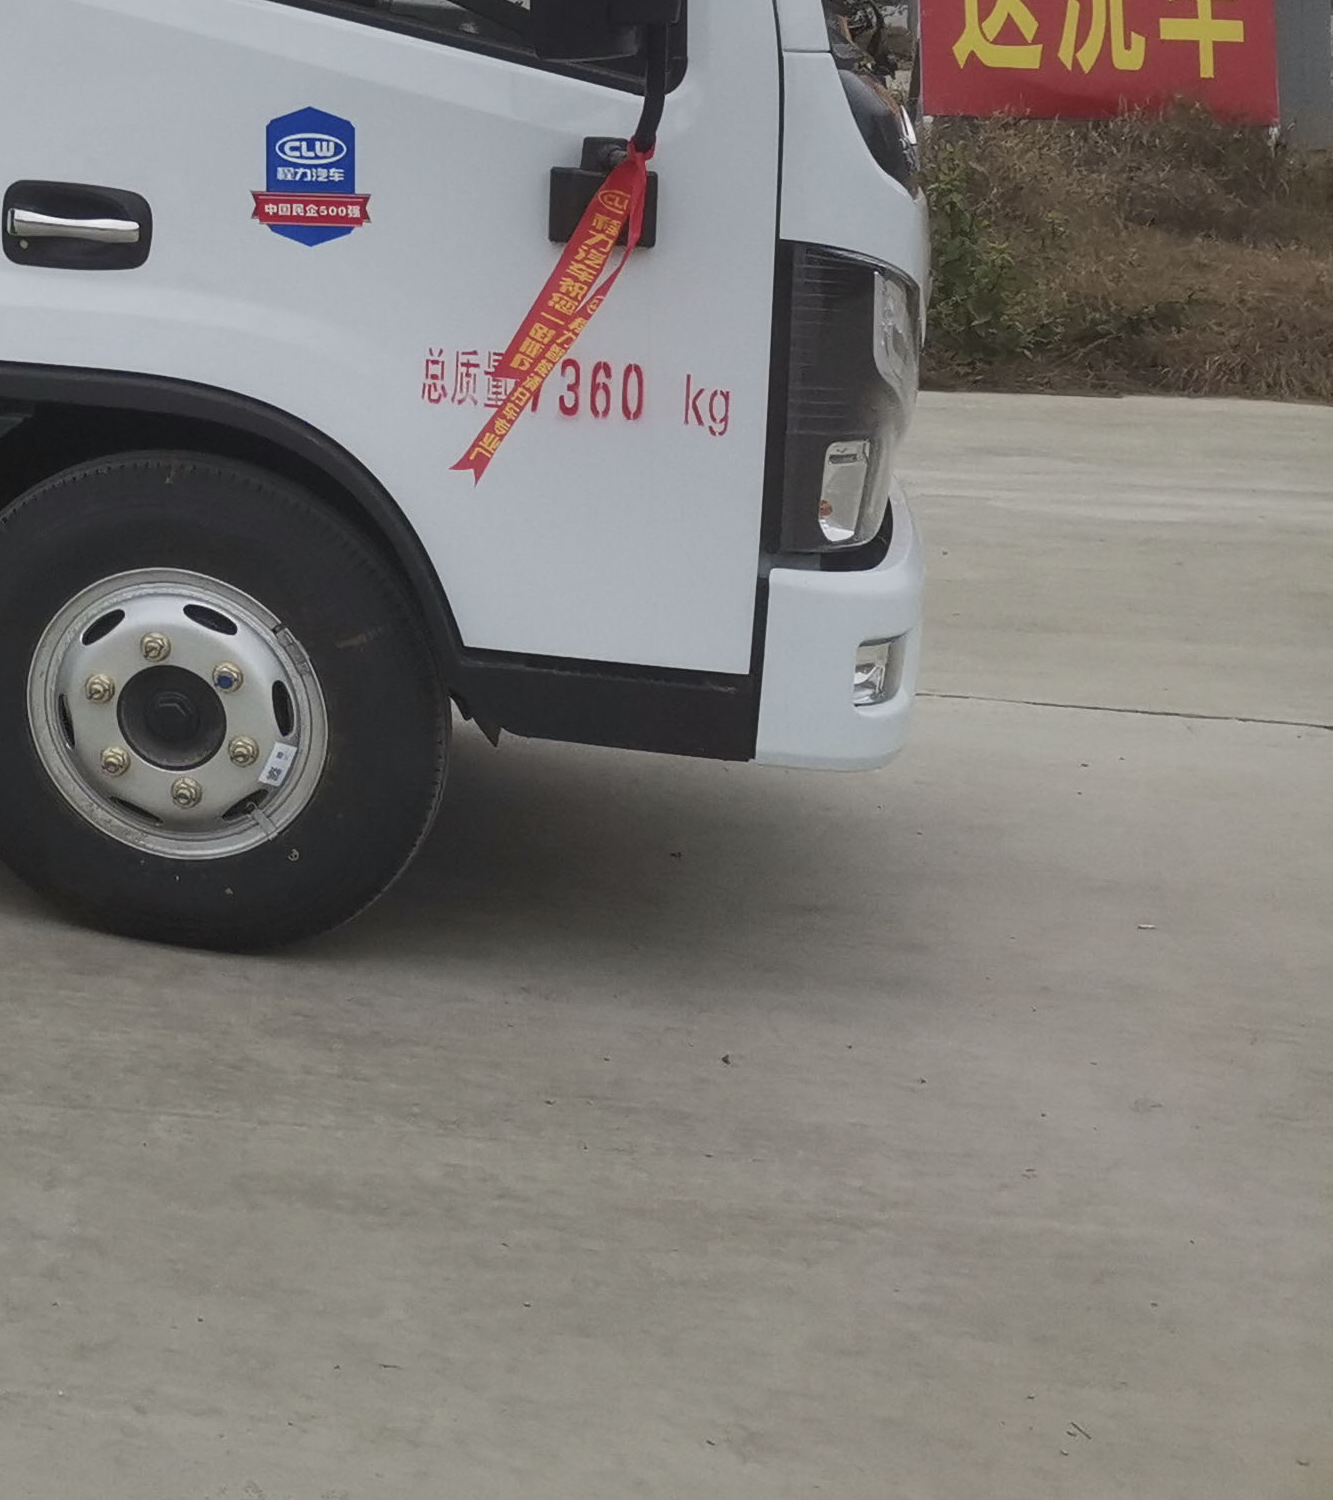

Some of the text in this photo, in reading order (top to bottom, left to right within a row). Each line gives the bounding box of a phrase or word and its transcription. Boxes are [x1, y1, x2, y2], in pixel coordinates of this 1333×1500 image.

[284, 141, 335, 157] CLW
[277, 167, 345, 181] 程力汽车
[683, 373, 731, 437] kg
